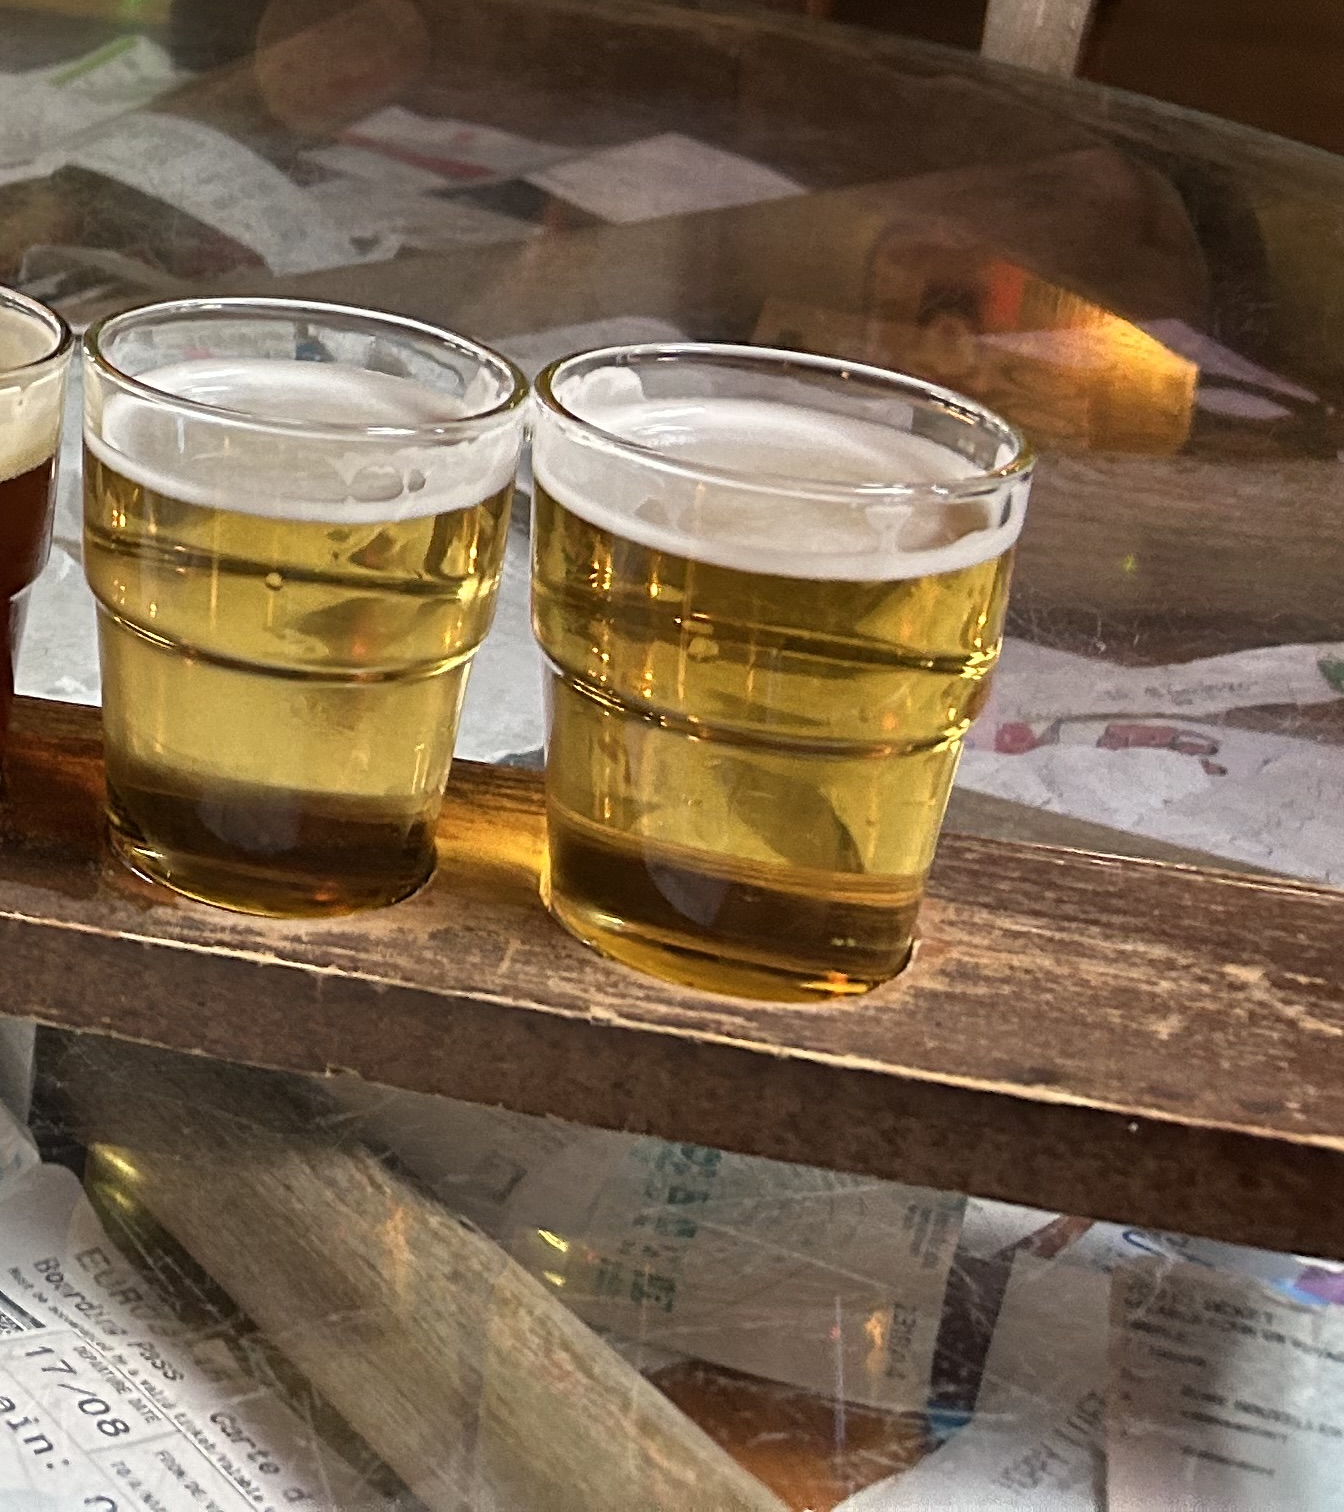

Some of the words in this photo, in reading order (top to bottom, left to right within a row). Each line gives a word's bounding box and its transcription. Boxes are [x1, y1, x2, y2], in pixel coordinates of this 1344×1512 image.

[25, 1345, 130, 1439] 17/08
[33, 1256, 128, 1337] Boarding
[127, 1338, 185, 1382] Pass
[209, 1411, 281, 1476] Carte
